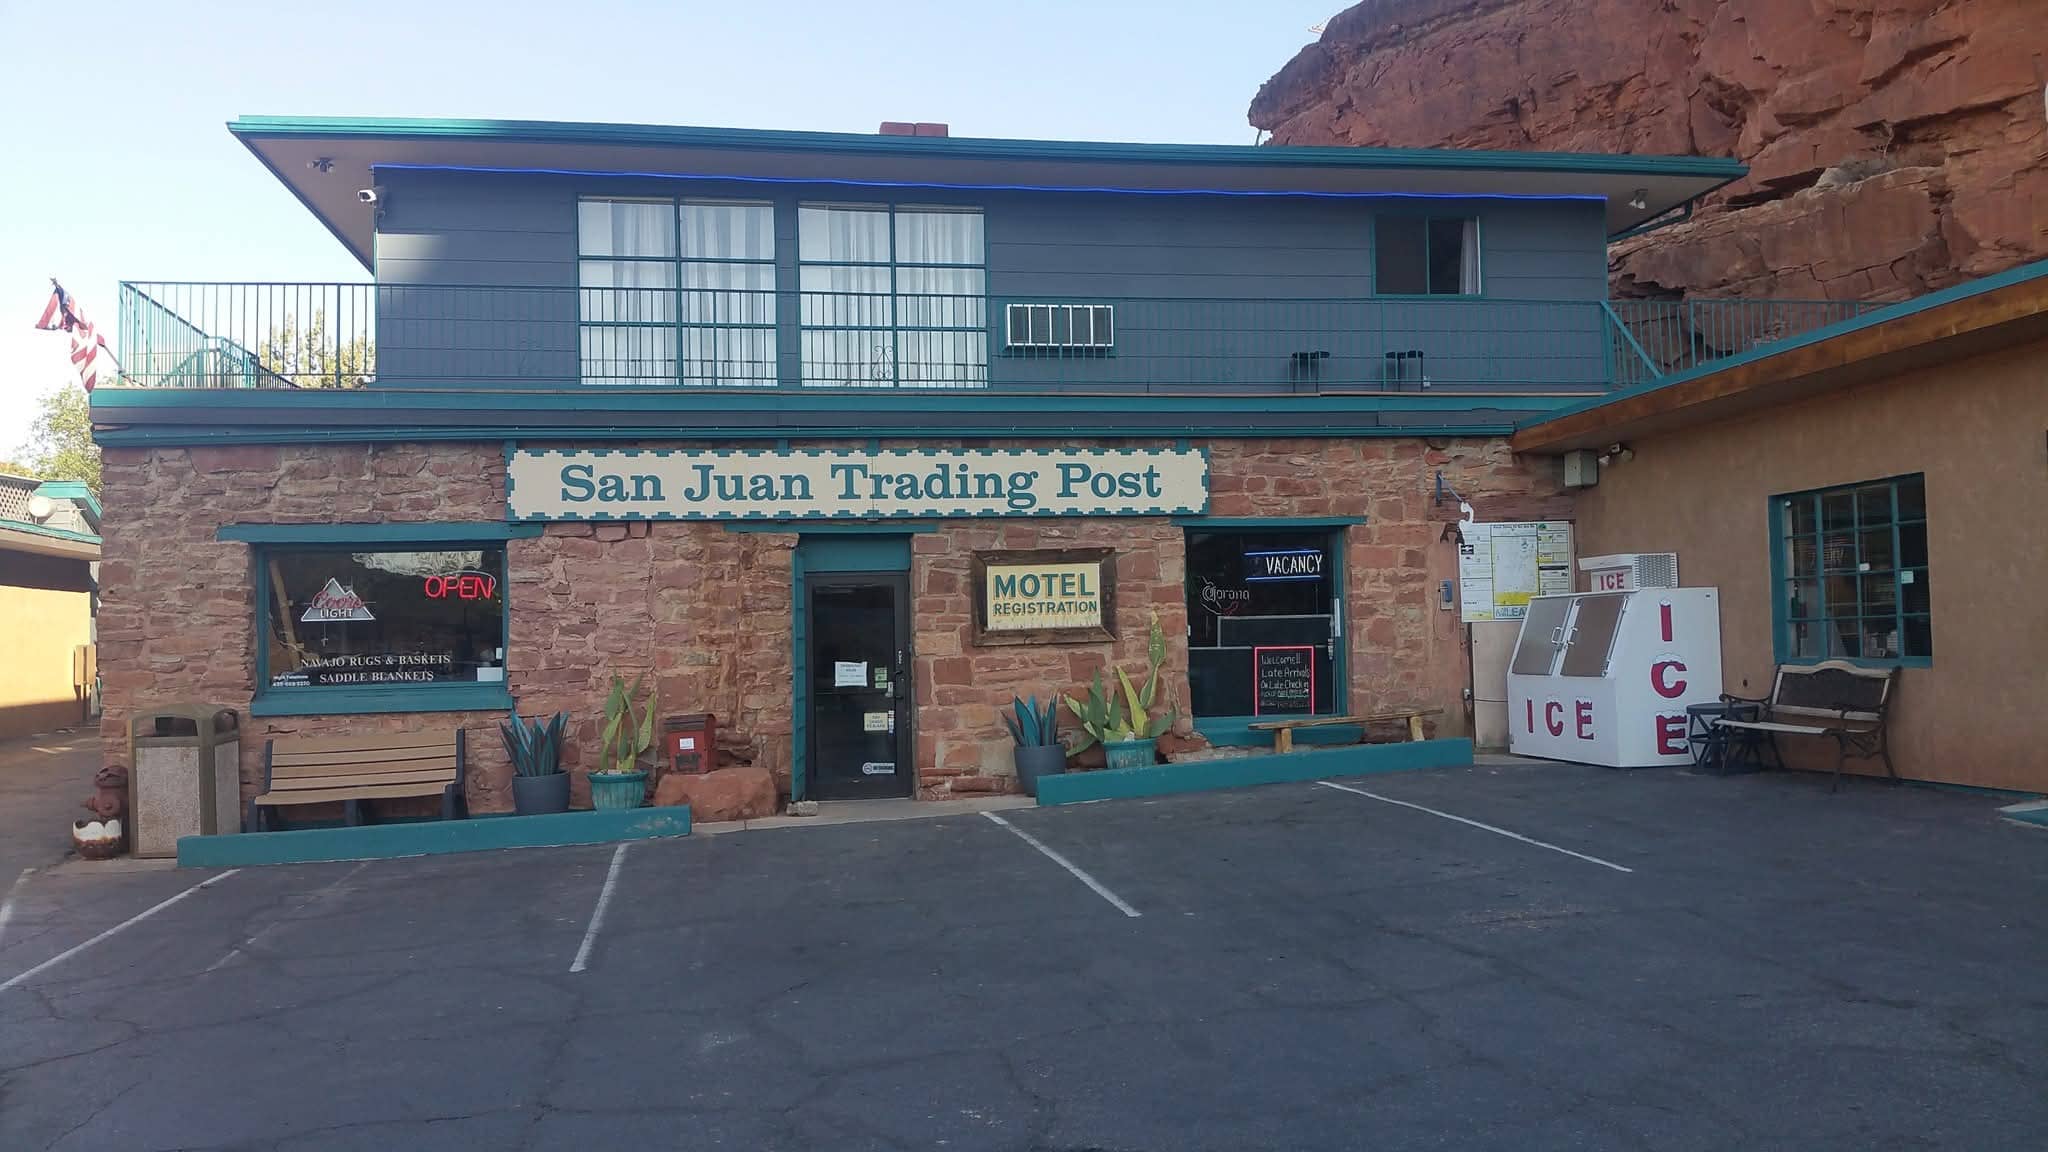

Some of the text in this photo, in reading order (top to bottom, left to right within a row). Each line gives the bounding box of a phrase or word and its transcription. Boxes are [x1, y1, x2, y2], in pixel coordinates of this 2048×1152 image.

[560, 462, 1162, 509] San Juan Trading Post
[1266, 553, 1323, 575] VACANCY
[425, 575, 493, 599] OPEN
[994, 572, 1095, 599] MOTEL
[1600, 572, 1625, 590] ICE
[311, 590, 362, 608] Coors
[1202, 585, 1249, 603] Corona
[319, 608, 354, 619] LIGHT
[994, 600, 1097, 616] REGISTRATION
[301, 654, 451, 668] NAVAJO RUGS & BASKETS
[319, 671, 367, 684] SADDLE
[372, 670, 435, 683] BLANKETS
[1261, 668, 1283, 678] Late
[1650, 598, 1690, 755] ICE
[1526, 694, 1595, 740] ICE
